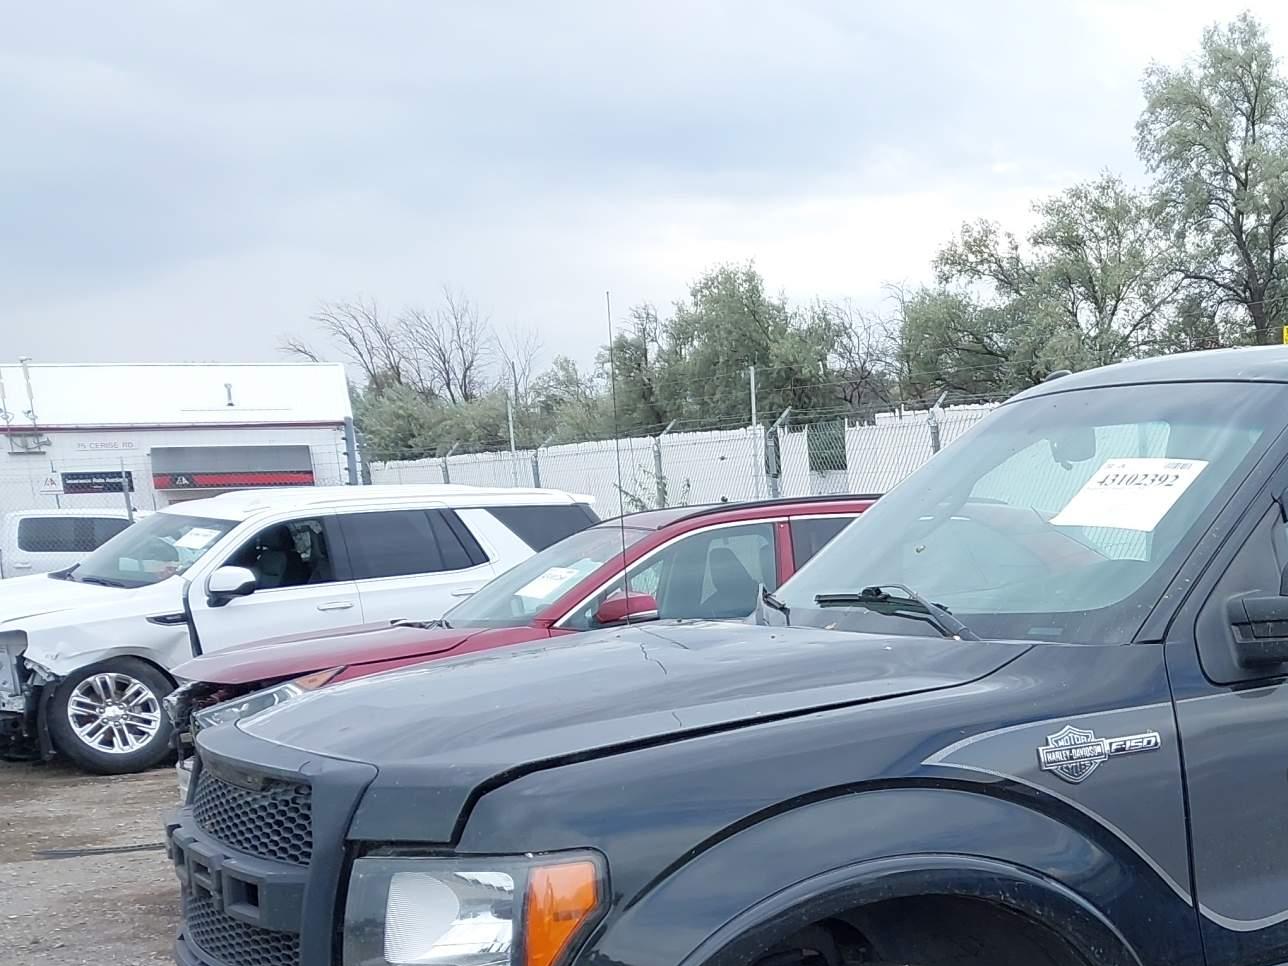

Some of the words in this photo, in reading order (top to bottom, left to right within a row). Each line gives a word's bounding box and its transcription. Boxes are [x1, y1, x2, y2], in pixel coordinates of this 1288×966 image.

[1097, 473, 1180, 487] 43102392
[1056, 733, 1088, 746] MOTOR
[1111, 736, 1157, 752] F-150
[1046, 744, 1102, 762] HARLEY-DAVIDSON
